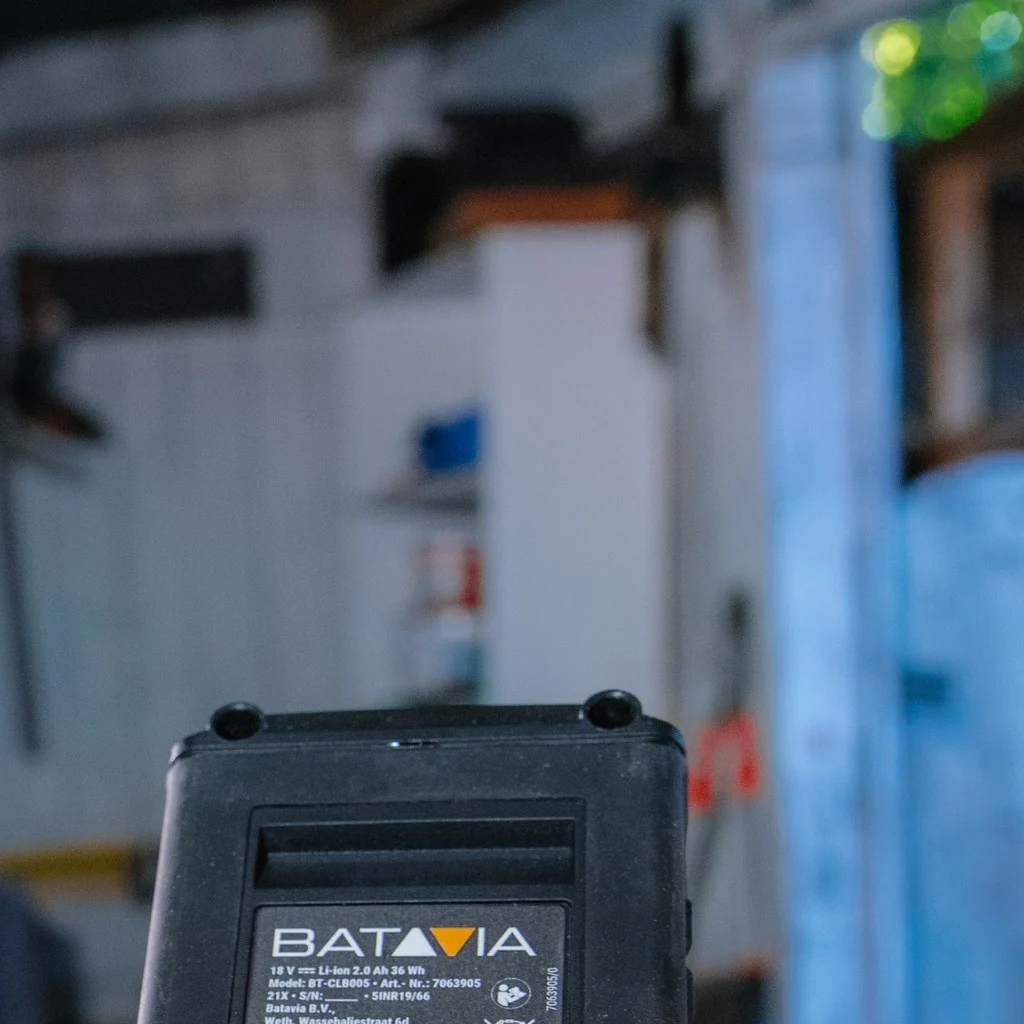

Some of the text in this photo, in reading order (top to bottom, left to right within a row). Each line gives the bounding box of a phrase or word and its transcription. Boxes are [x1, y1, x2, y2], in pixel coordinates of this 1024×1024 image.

[272, 927, 537, 957] BATAVIA
[271, 966, 426, 976] 18 V Li-ion 2.0 Ah 36 Wh
[268, 978, 482, 989] Model: BT-CLB005 Art.- Nr.: 7063905
[545, 967, 559, 1012] 7063905/0
[299, 991, 324, 1001] S/N:
[265, 1004, 336, 1016] Batavia B.V.,
